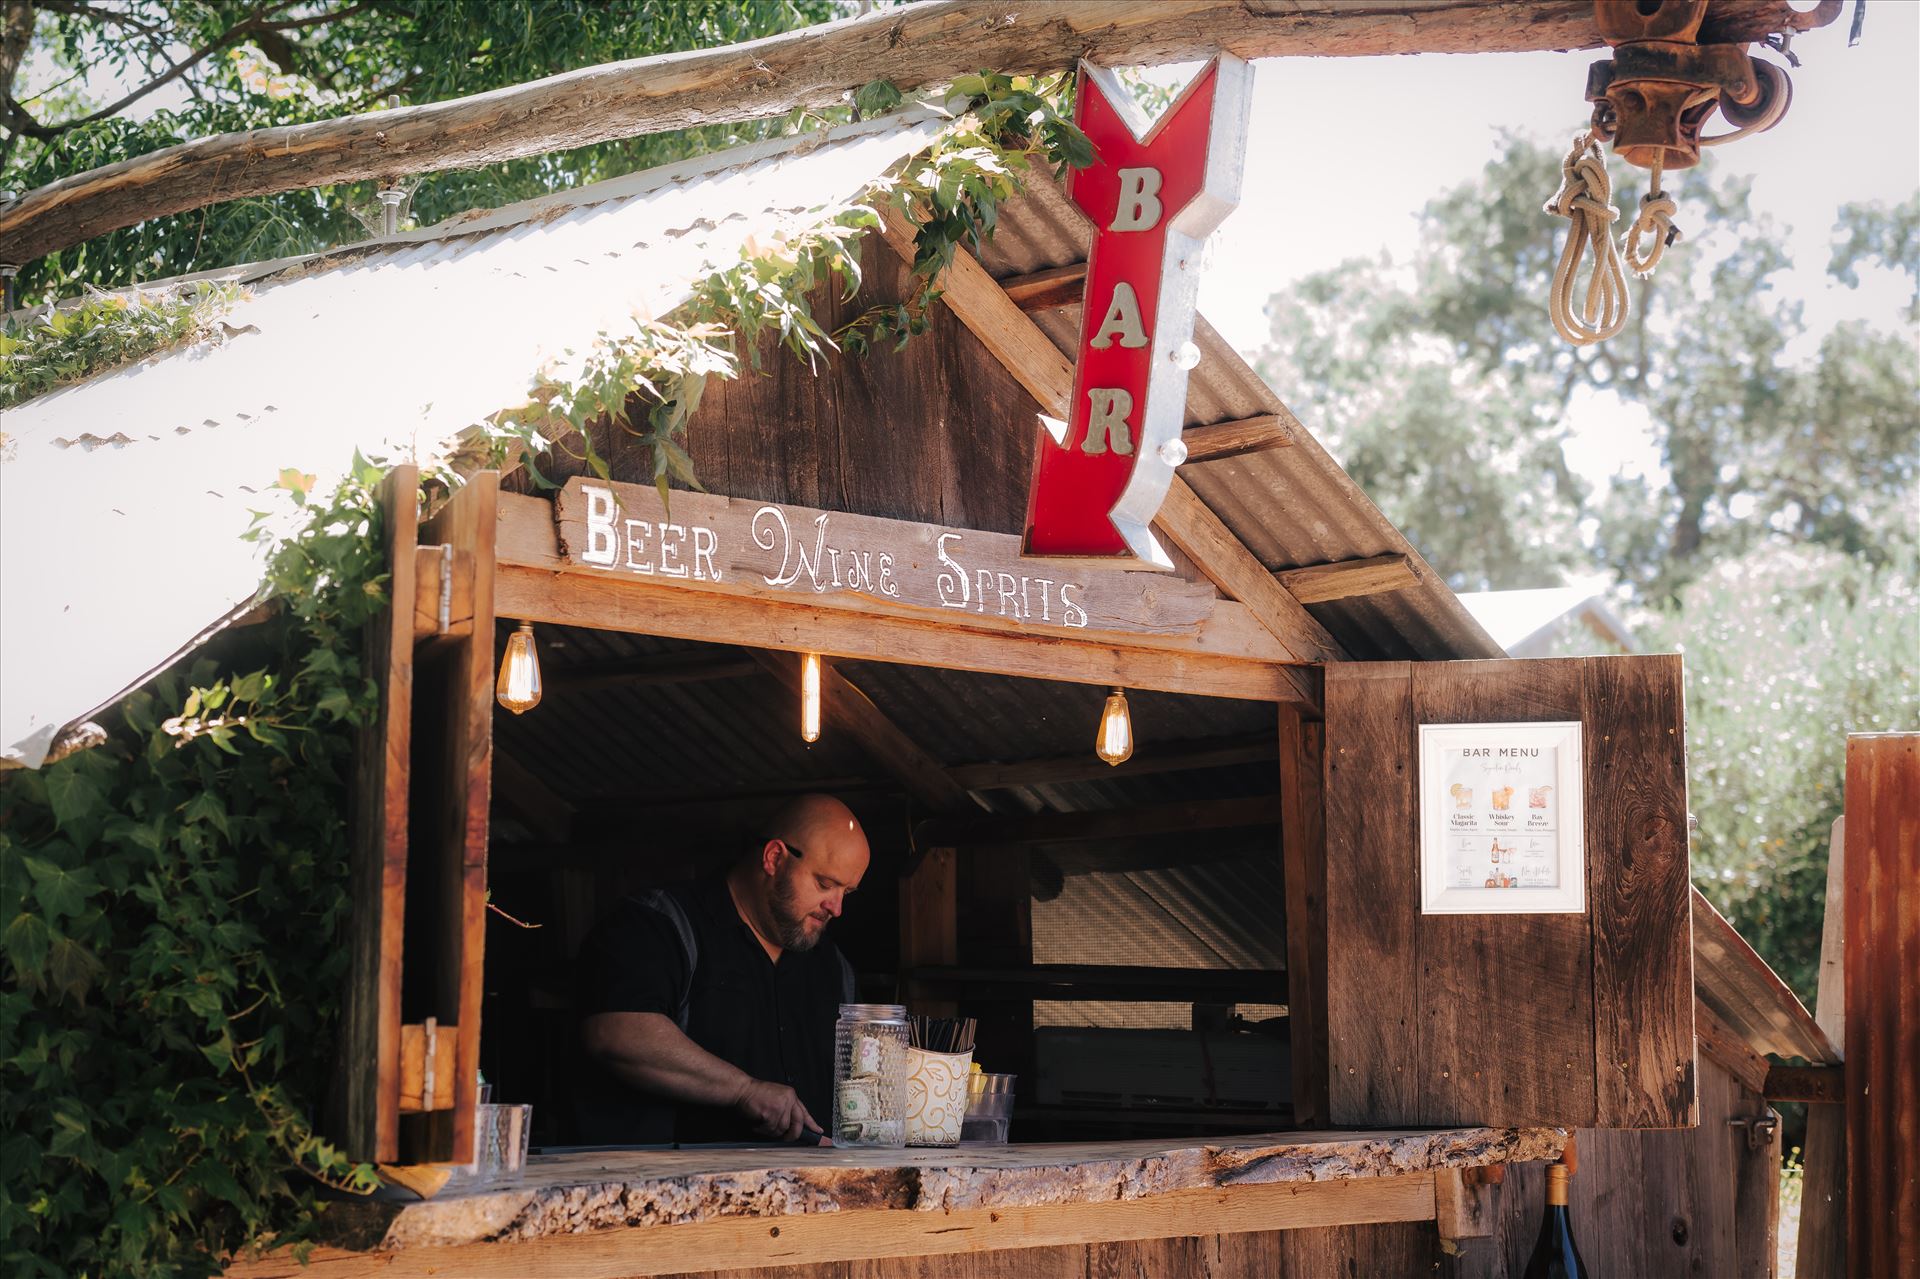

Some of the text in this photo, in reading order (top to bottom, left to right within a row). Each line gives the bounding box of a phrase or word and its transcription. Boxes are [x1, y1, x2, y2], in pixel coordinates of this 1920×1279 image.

[1081, 167, 1163, 456] BAR
[580, 484, 722, 582] BEER
[750, 505, 900, 598] WINE
[1463, 747, 1539, 757] BAR MENU
[1488, 813, 1515, 821] Whiskey
